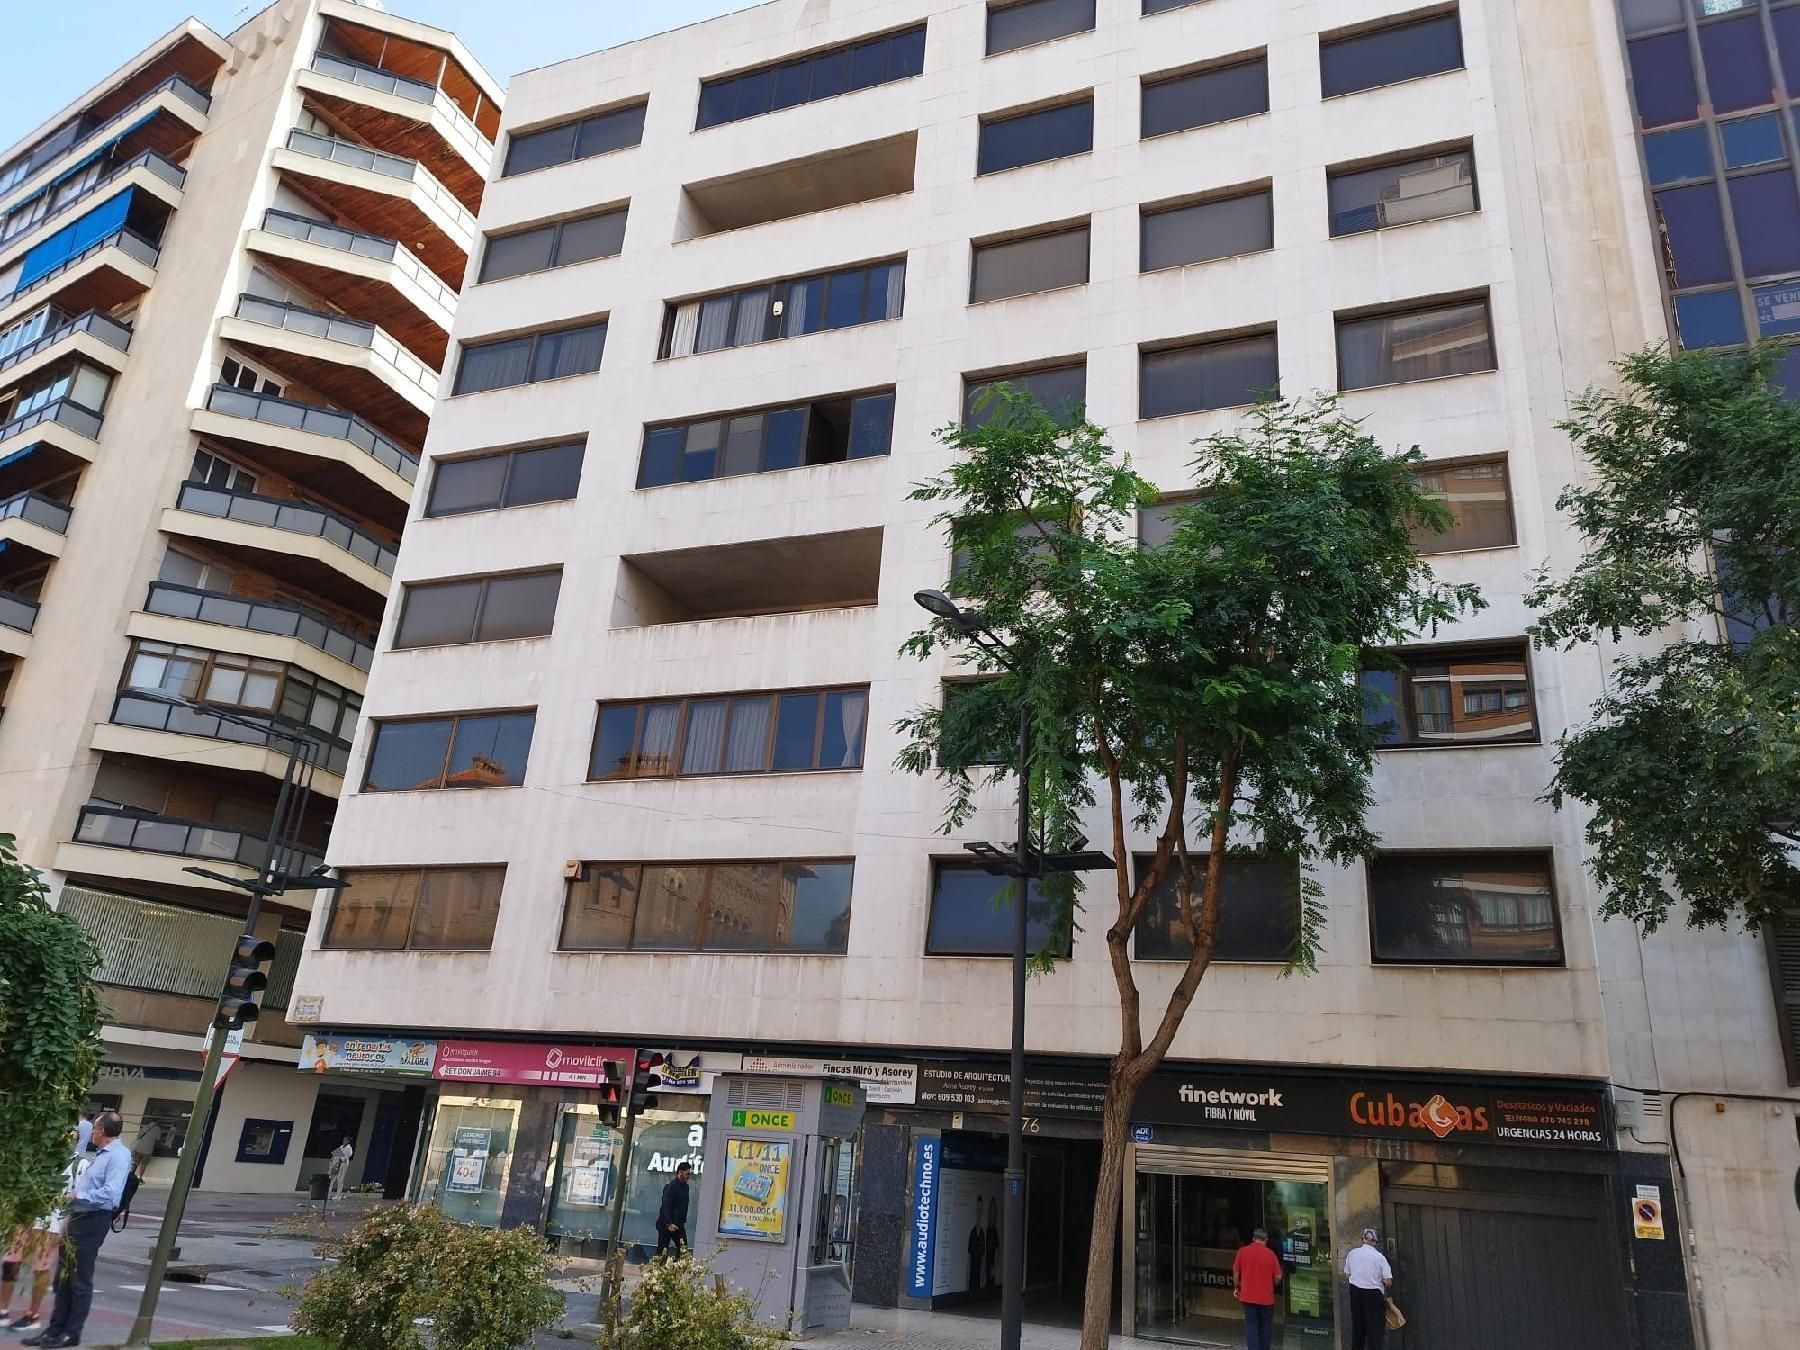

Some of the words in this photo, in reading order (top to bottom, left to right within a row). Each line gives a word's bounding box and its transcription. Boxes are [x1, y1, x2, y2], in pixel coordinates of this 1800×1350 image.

[98, 1066, 145, 1080] BBVA
[822, 1063, 851, 1074] Fincas
[852, 1065, 873, 1076] Miró
[874, 1068, 880, 1077] y
[881, 1066, 914, 1079] Asorey
[923, 1069, 952, 1079] ESTUDIO
[953, 1071, 963, 1080] DE
[963, 1072, 1012, 1083] ARQUITECTUR
[832, 1090, 852, 1104] ONCE
[1178, 1084, 1284, 1107] finetwork
[1204, 1106, 1227, 1120] FIBRA
[1227, 1108, 1233, 1120] Y
[1497, 1100, 1547, 1112] Desatascos
[1554, 1103, 1596, 1113] Vaciados
[750, 1113, 789, 1127] ONCE
[1021, 1116, 1040, 1133] 76
[1497, 1126, 1552, 1140] URGENCIAS
[1552, 1129, 1566, 1140] 24
[1566, 1129, 1602, 1142] HORAS
[760, 1164, 780, 1175] ONCE
[915, 1144, 934, 1288] www.audiotechno.es
